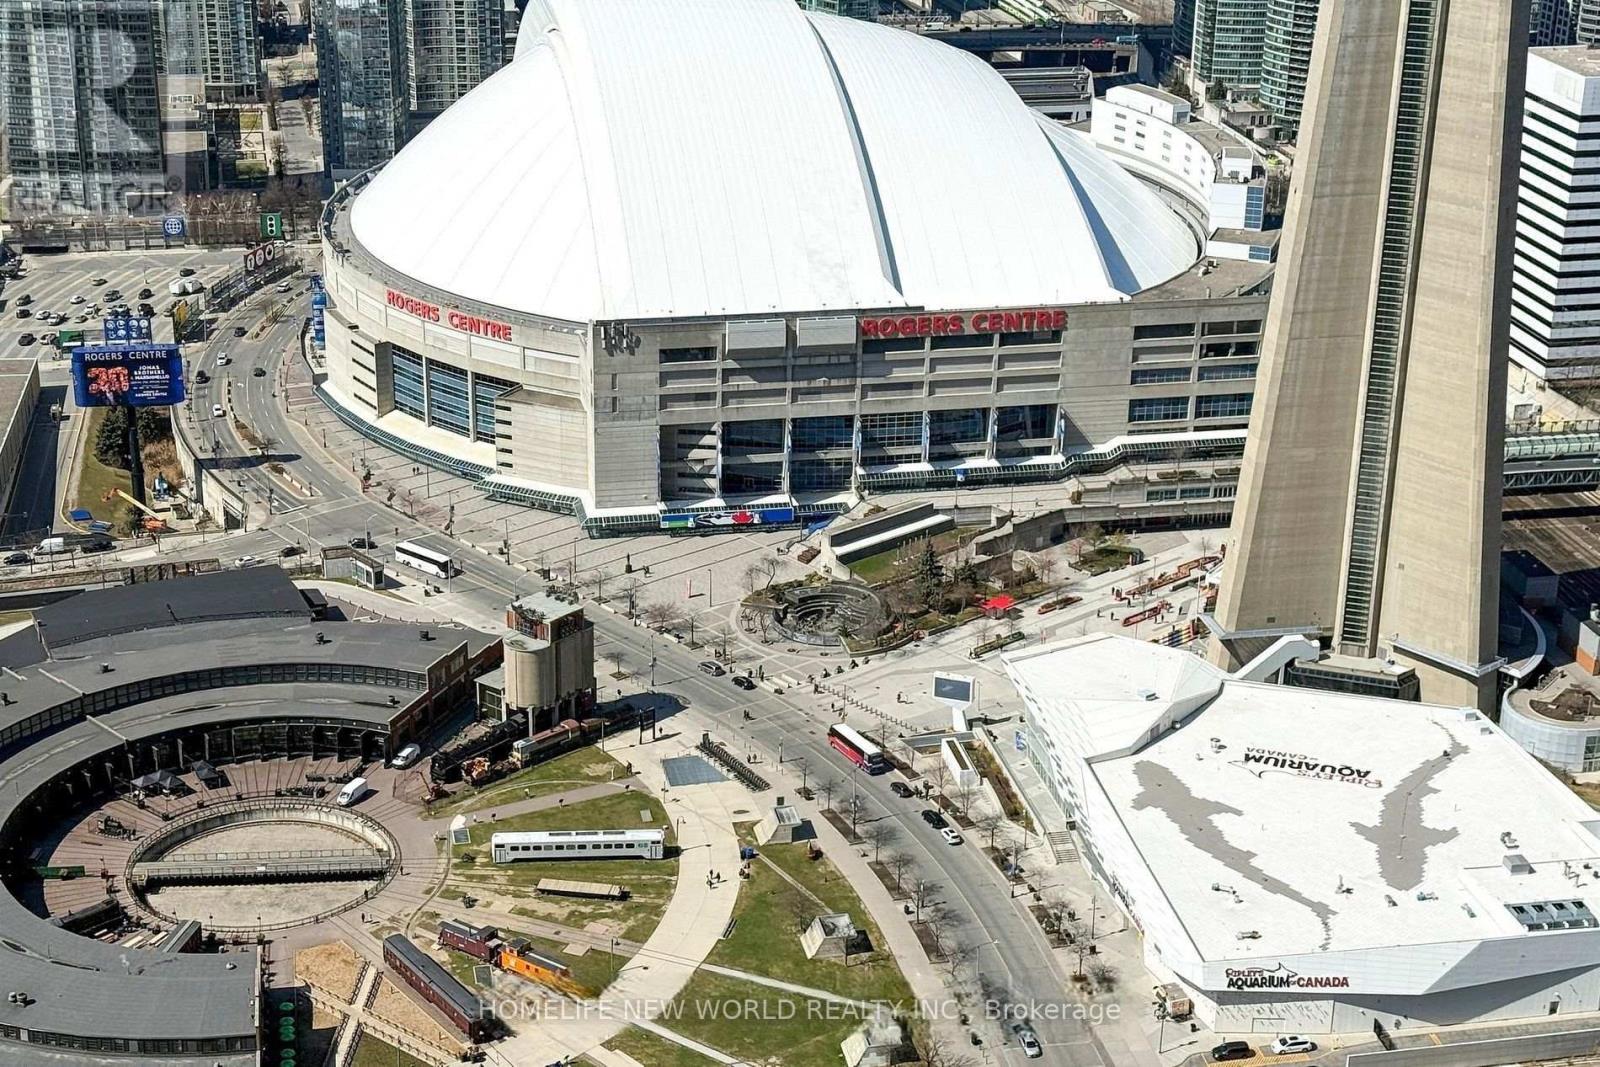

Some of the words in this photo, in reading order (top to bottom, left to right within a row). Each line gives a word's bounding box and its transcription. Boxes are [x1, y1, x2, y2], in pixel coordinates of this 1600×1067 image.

[386, 289, 440, 322] ROGERS
[447, 311, 513, 342] CENTRE
[861, 314, 964, 338] ROGERS
[971, 310, 1068, 333] CENTRE
[84, 352, 123, 361] ROGERS
[128, 350, 167, 360] CENTRE
[1246, 746, 1308, 760] CANADA
[1244, 753, 1372, 779] AQUARIUM
[1226, 975, 1290, 990] AQUARIUM
[1296, 976, 1350, 988] CANADA
